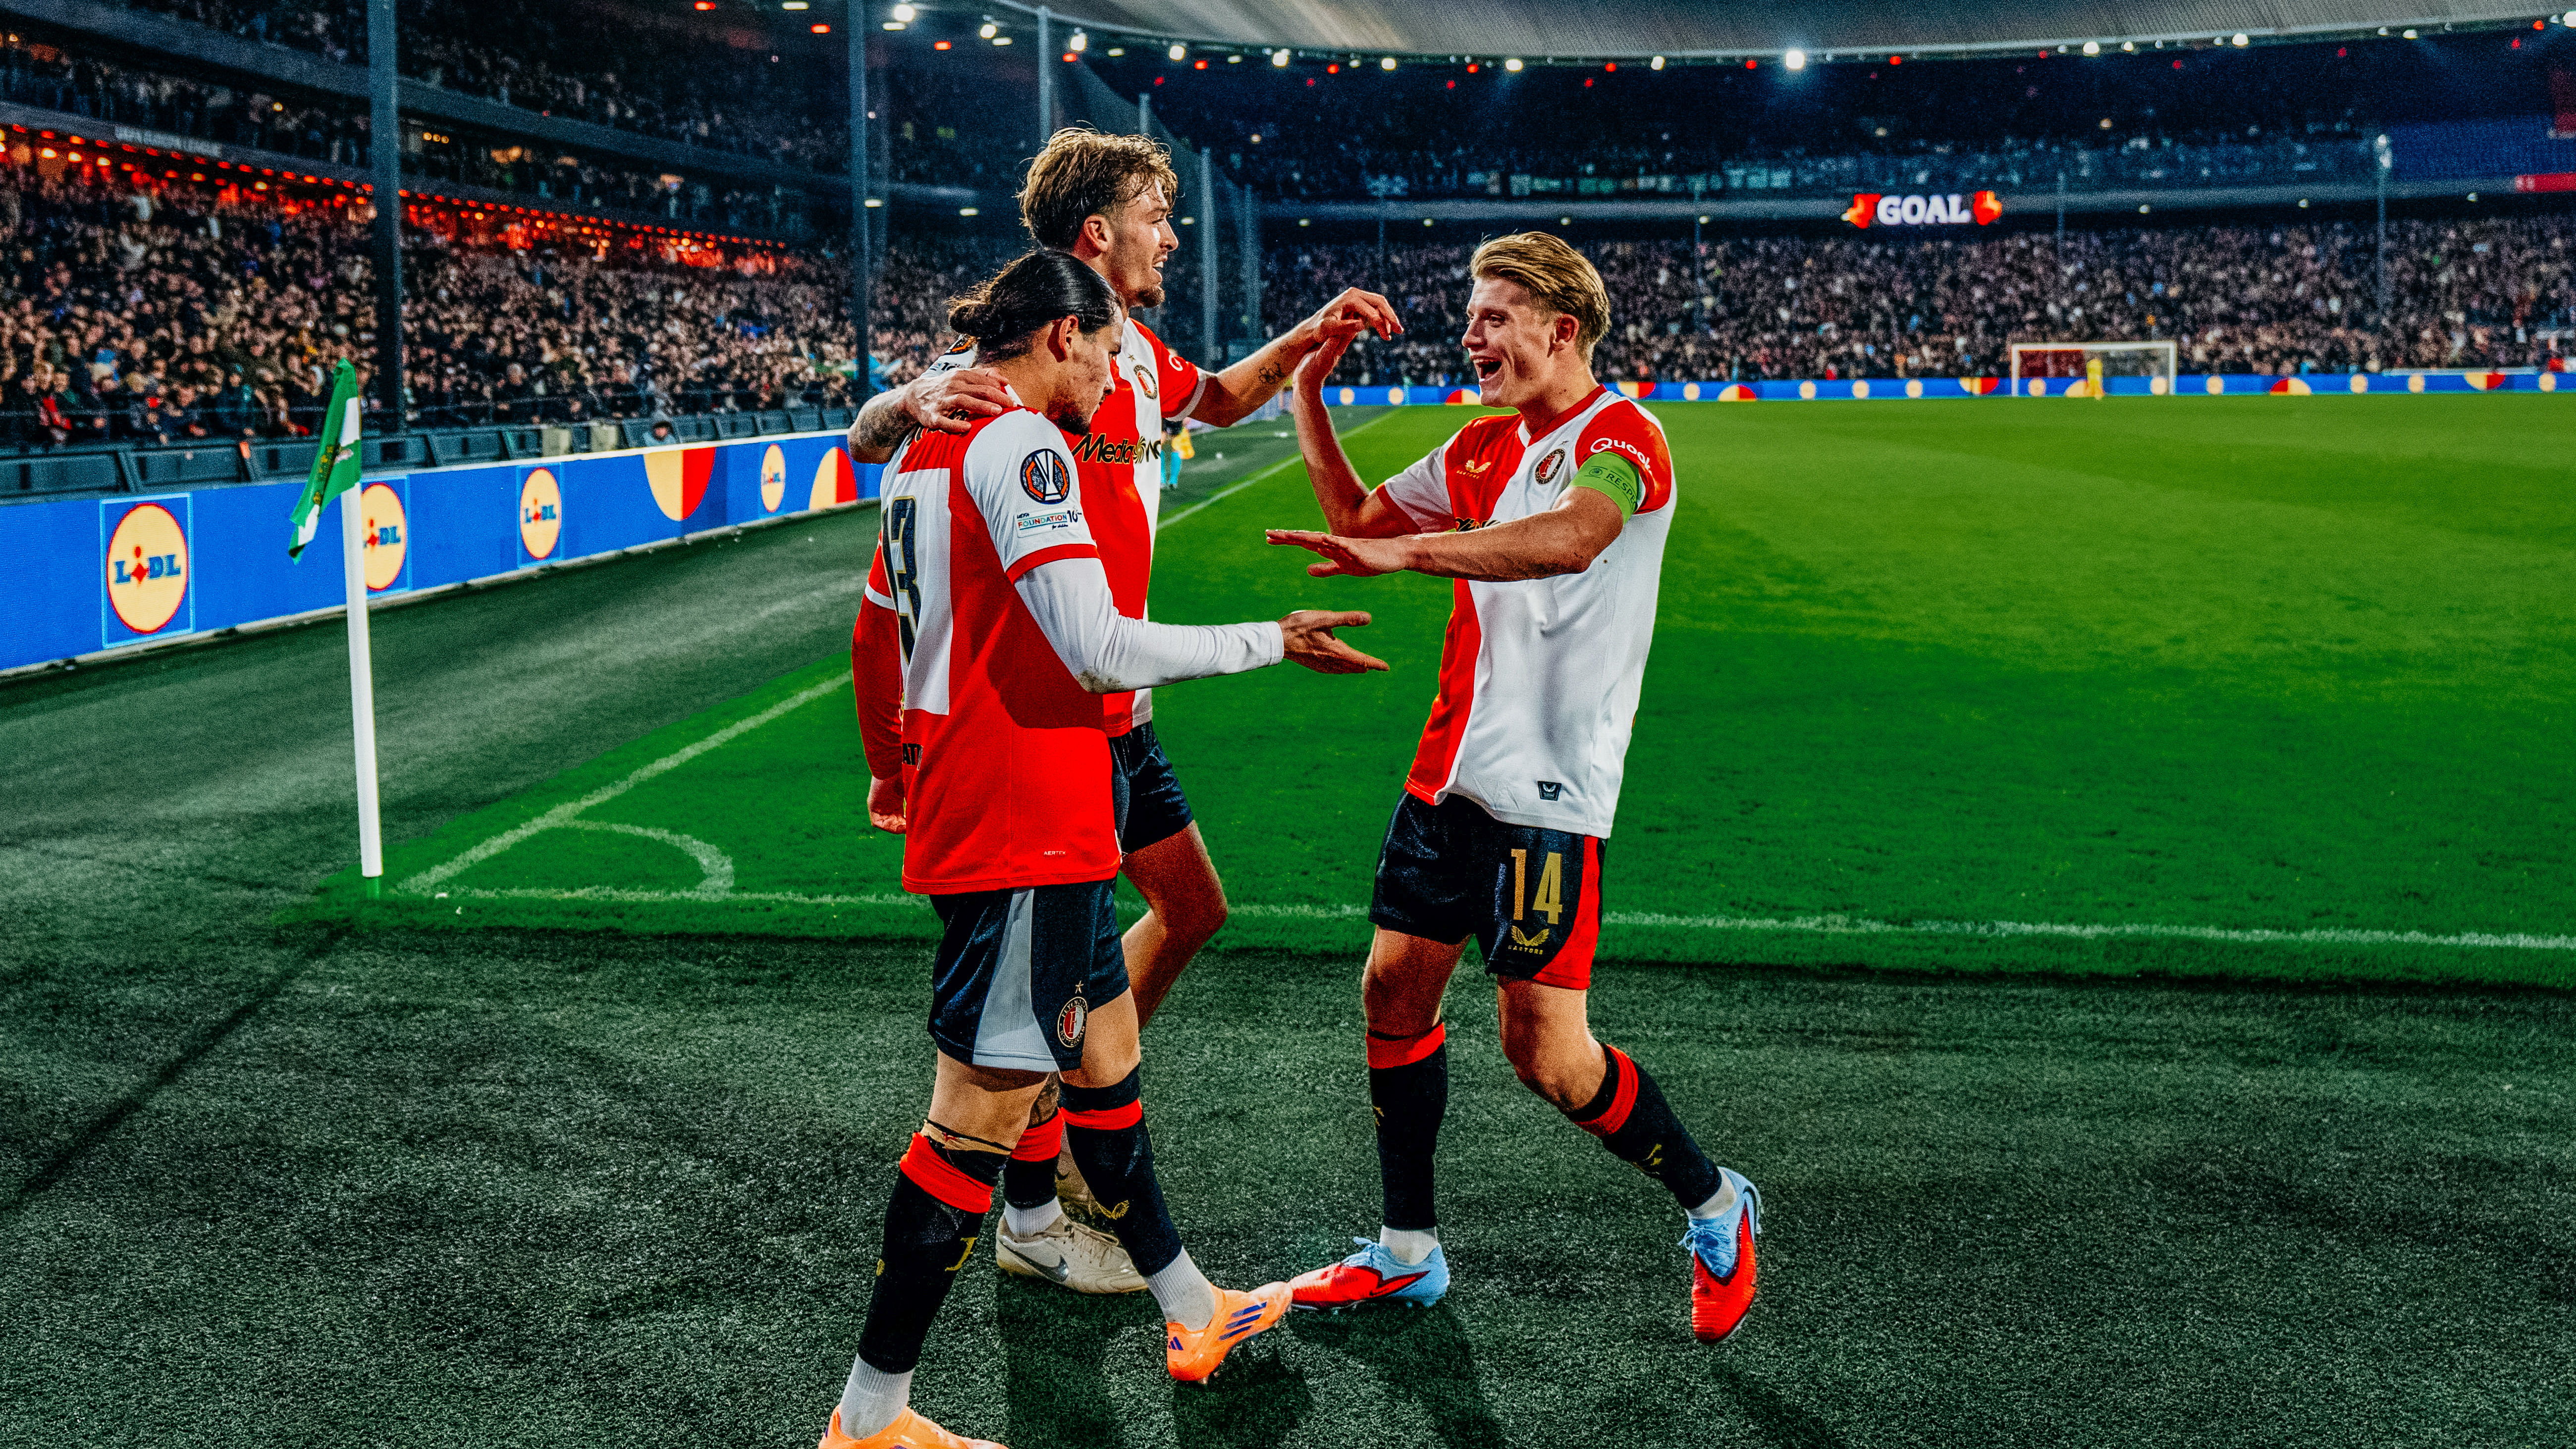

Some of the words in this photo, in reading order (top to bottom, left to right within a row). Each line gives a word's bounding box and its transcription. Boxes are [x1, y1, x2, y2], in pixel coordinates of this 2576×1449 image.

[1877, 194, 1971, 225] GOAL
[1590, 437, 1652, 476] Quook
[1018, 514, 1068, 528] FOUNDATION
[882, 496, 922, 665] 13
[1511, 848, 1563, 925] 14
